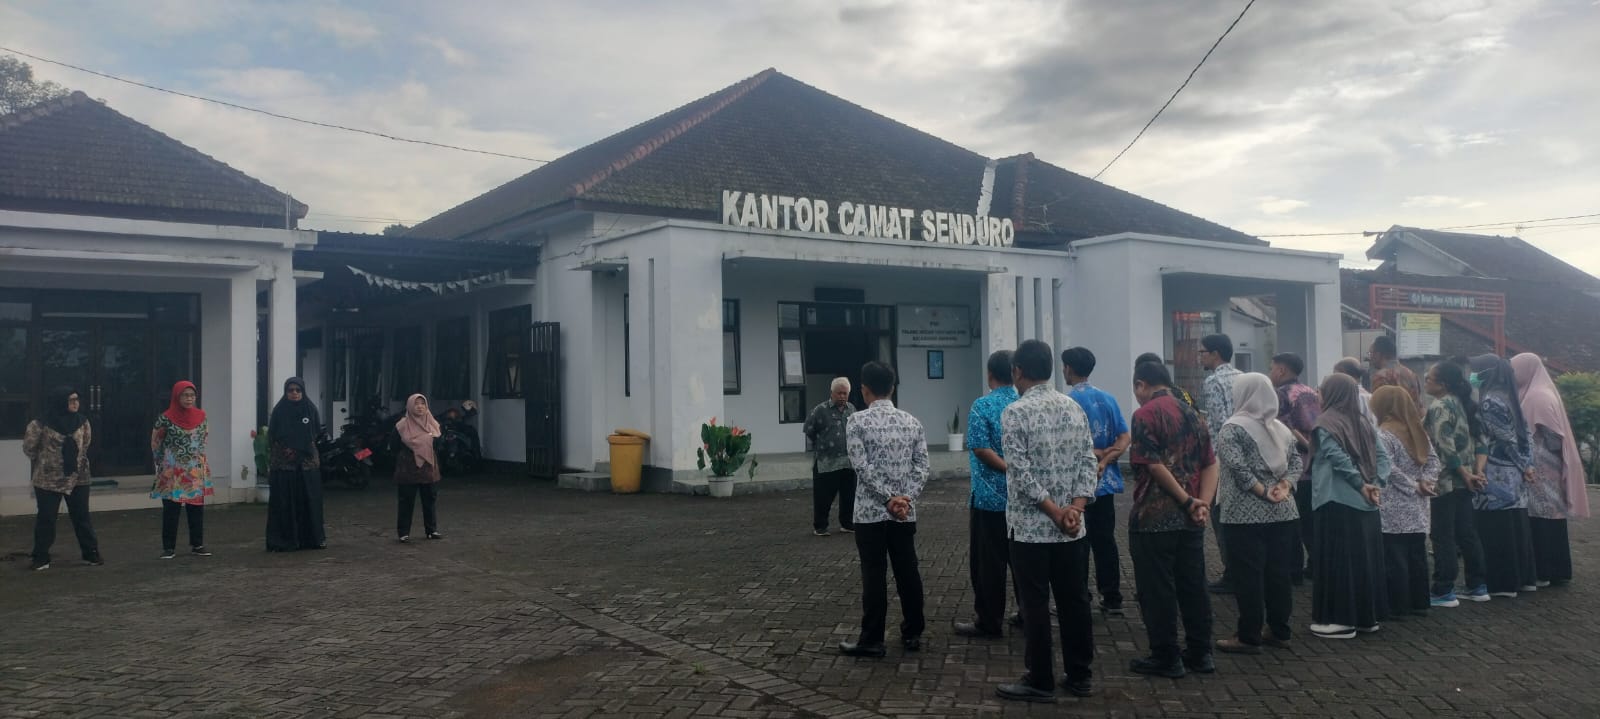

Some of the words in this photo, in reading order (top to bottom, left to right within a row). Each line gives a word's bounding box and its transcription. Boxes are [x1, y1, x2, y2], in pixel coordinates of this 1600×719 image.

[722, 190, 829, 233] KANTOR
[838, 201, 915, 240] CAMAT
[921, 209, 1015, 247] SENDURO
